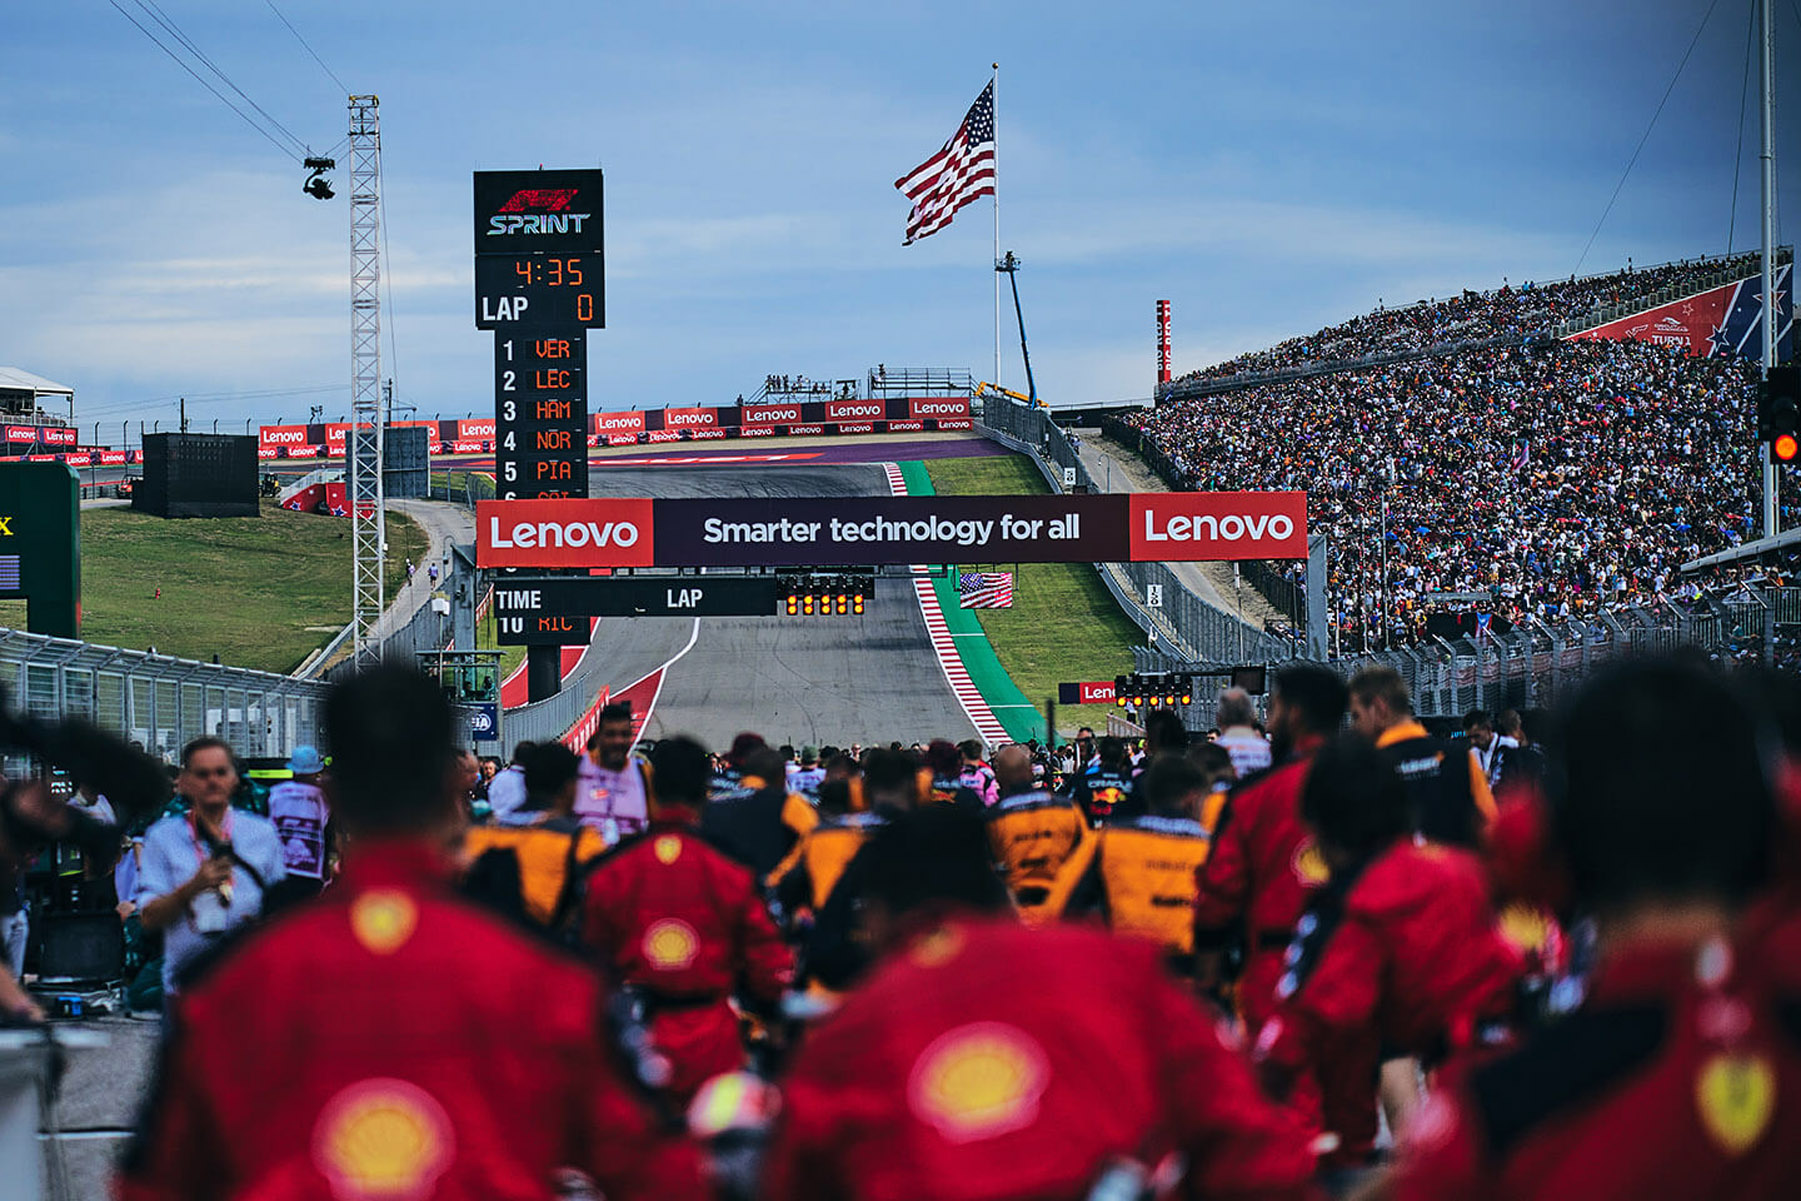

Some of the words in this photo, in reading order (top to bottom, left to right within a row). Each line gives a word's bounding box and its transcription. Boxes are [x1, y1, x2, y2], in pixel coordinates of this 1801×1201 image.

[487, 213, 591, 235] SPRINT
[516, 259, 583, 286] 4:35
[482, 296, 528, 321] LAP
[577, 294, 593, 321] 0
[1652, 335, 1683, 346] TURN
[503, 340, 513, 361] 1
[536, 340, 570, 358] VER
[503, 371, 516, 391] 2
[536, 370, 570, 389] LEC
[503, 401, 516, 421] 3
[537, 401, 571, 419] HAM
[830, 405, 881, 417] Lenovo
[914, 402, 965, 414] Lenovo
[668, 412, 713, 425] Lenovo
[746, 410, 797, 422] Lenovo
[462, 423, 496, 436] Lenov
[598, 417, 641, 429] Lenovo
[840, 425, 871, 433] Lenovo
[939, 421, 970, 429] Lenovo
[264, 430, 303, 443] Lenovo
[694, 429, 723, 439] Lenovo
[741, 428, 772, 437] Lenovo
[790, 426, 821, 435] Lenovo
[455, 443, 481, 451] Lenovo
[504, 431, 516, 451] 4
[537, 431, 571, 449] NOR
[504, 461, 517, 481] 5
[537, 461, 571, 480] PIA
[703, 518, 821, 543] Smarter
[830, 515, 994, 546] technology
[1000, 514, 1044, 540] for
[1048, 513, 1080, 539] all
[1145, 509, 1294, 541] Lenovo
[491, 516, 639, 548] Lenovo
[495, 590, 541, 609] TIME
[667, 589, 703, 608] LAP
